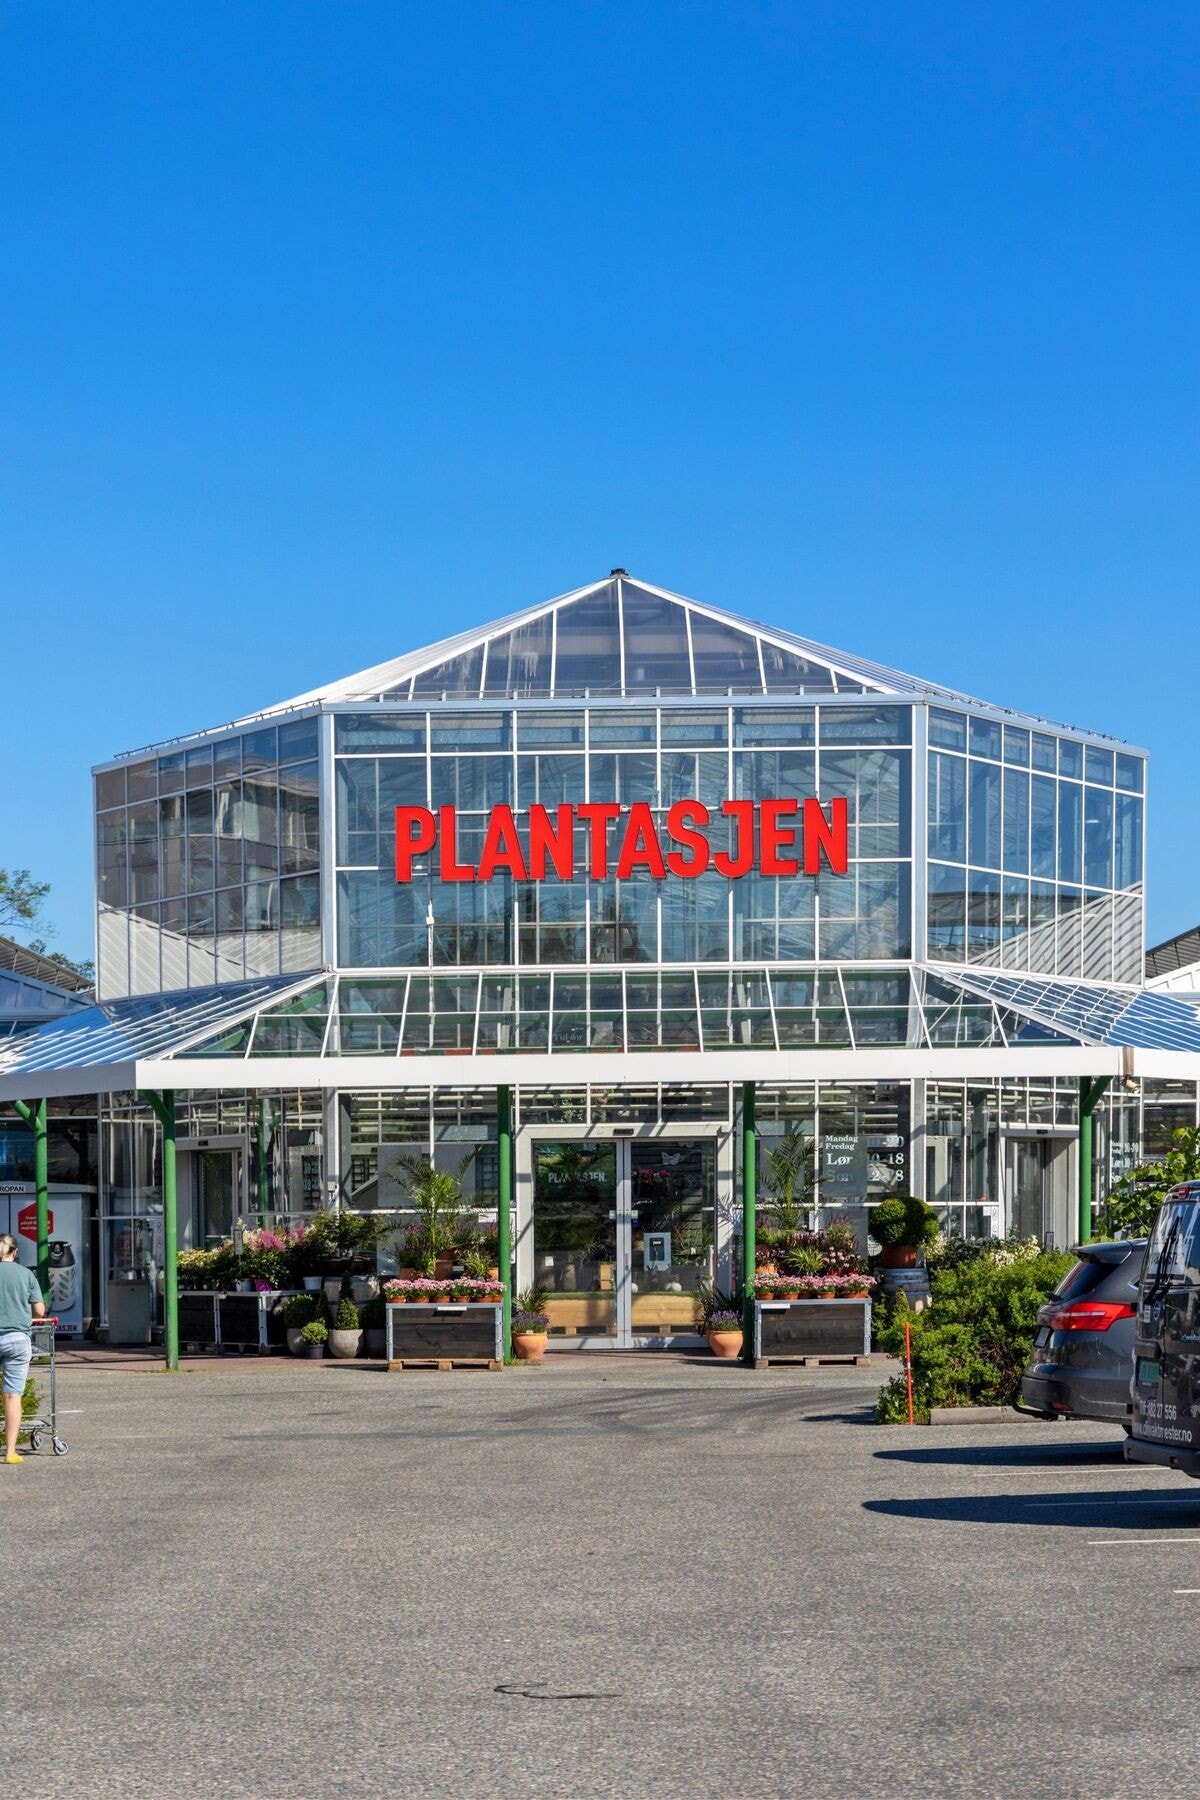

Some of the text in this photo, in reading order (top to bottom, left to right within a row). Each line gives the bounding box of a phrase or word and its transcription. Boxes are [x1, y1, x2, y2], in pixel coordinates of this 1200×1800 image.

[395, 797, 848, 882] PLANTASJEN
[825, 1143, 855, 1151] Fredag
[826, 1153, 853, 1165] Lør
[1164, 1404, 1177, 1421] 556
